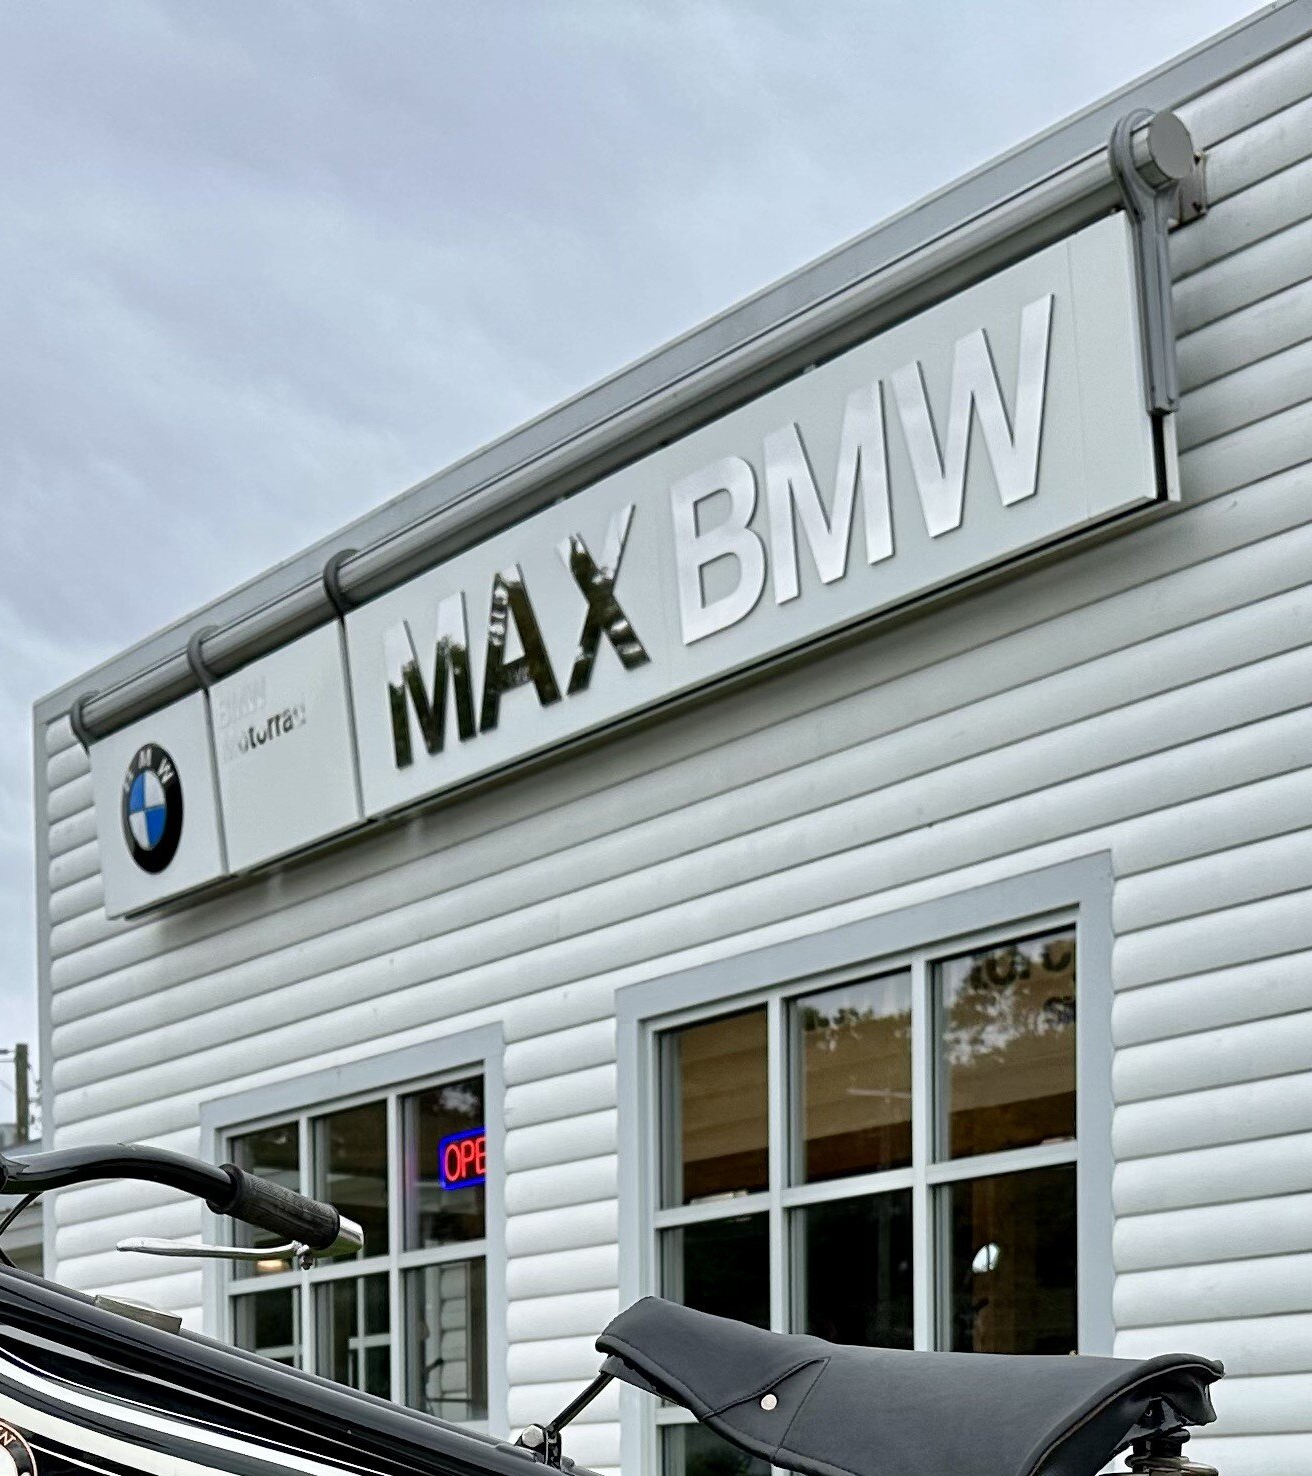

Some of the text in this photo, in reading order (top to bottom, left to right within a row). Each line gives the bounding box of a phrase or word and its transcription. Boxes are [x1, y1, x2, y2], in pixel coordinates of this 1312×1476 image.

[386, 292, 1055, 769] MAX BMW
[444, 1136, 486, 1182] OPE
